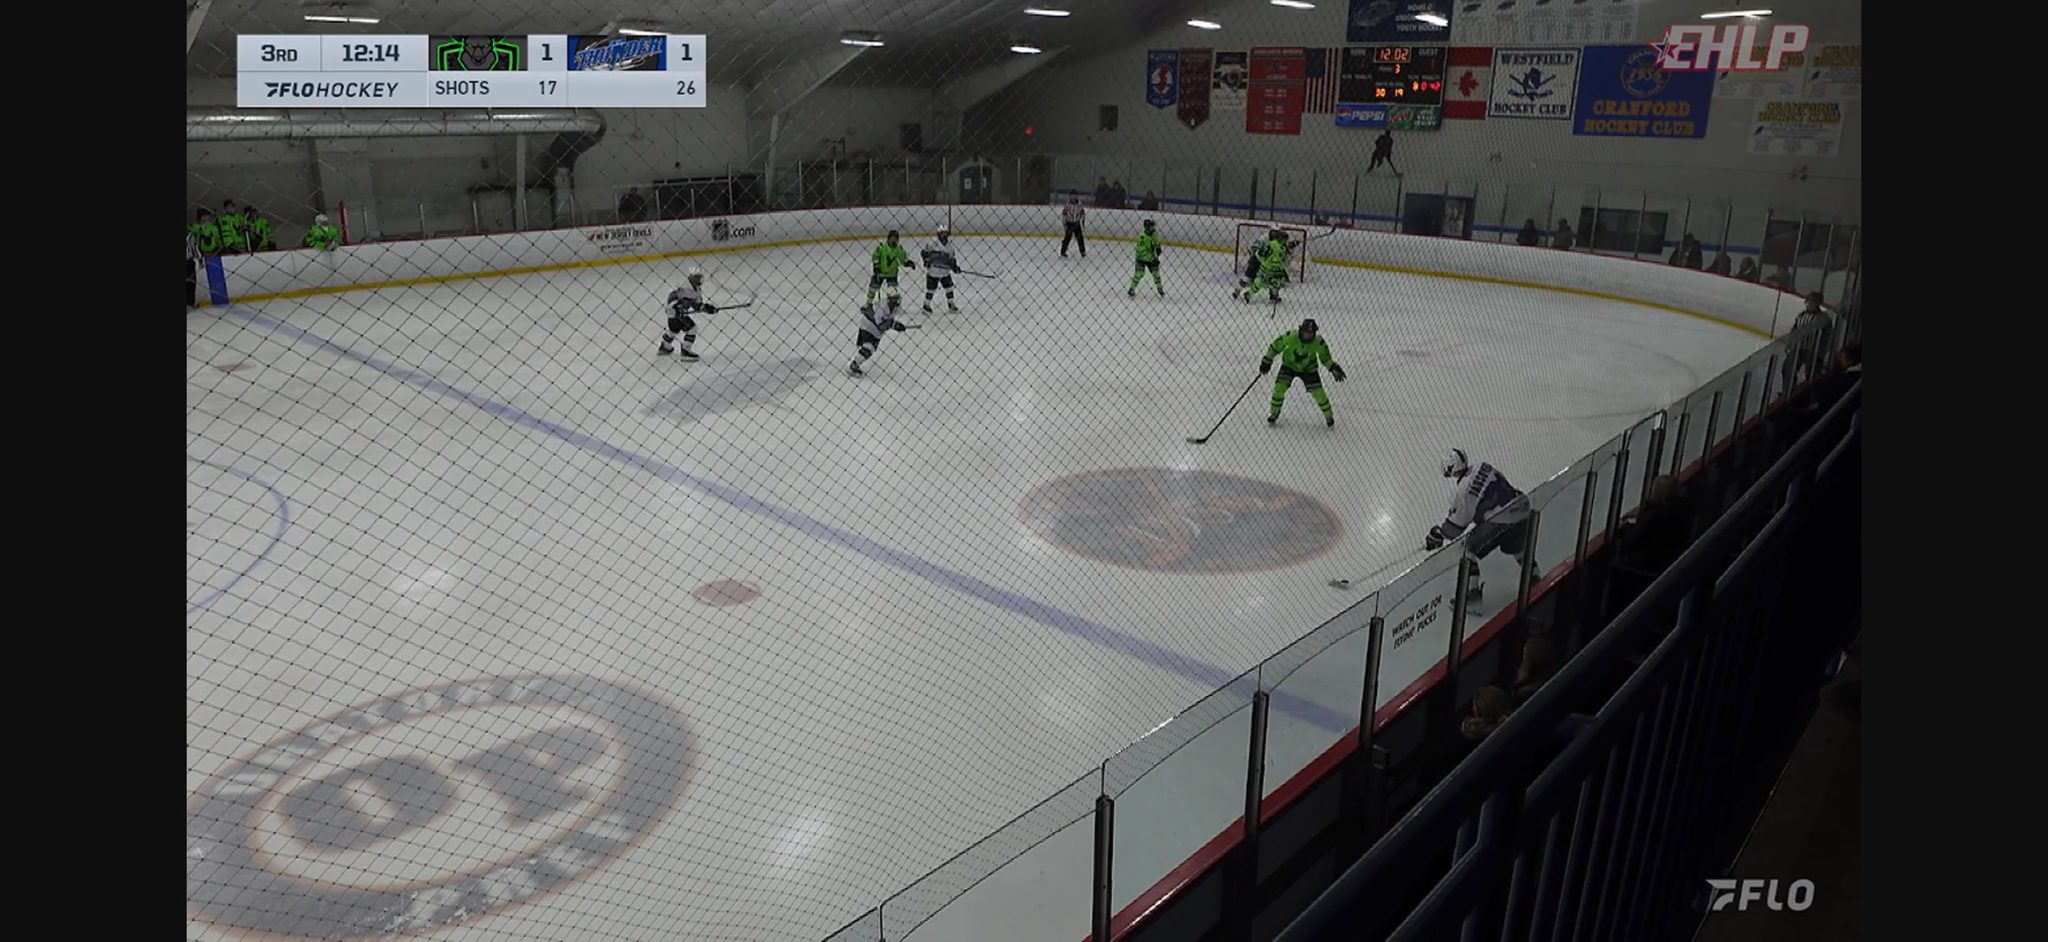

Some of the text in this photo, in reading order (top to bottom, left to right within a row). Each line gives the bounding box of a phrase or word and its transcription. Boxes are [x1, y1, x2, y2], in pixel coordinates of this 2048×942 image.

[1396, 24, 1417, 32] YOUTH
[1501, 53, 1574, 65] WESTFIELD
[1394, 64, 1401, 74] 3
[1494, 102, 1567, 114] HOCKEY CLUB
[1592, 99, 1691, 117] CRANFORD
[1351, 110, 1386, 121] PEPSI
[1584, 118, 1695, 135] HOCKEY CLUB
[596, 232, 610, 241] NEW
[633, 228, 652, 238] DEVILS
[730, 224, 755, 239] .com
[1392, 594, 1442, 637] WATCH OUT FOR
[1417, 610, 1437, 632] PUCKS
[279, 725, 610, 854] OP
